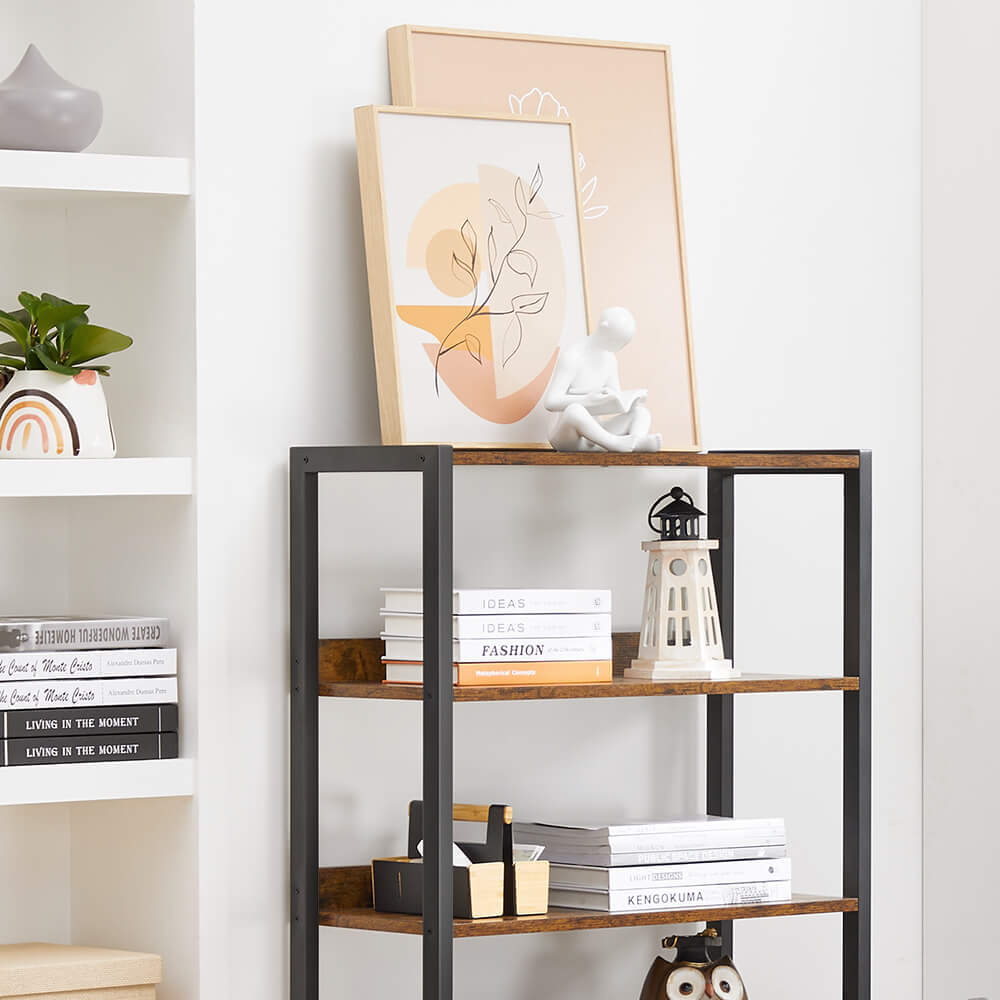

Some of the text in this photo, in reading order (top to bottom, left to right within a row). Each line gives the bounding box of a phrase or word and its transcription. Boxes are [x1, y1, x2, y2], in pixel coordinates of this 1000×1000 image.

[482, 599, 526, 609] IDEAS
[35, 625, 161, 645] CREATE WONDERFUL HOMELIFE
[482, 623, 525, 633] IDEAS
[481, 644, 545, 657] FASHION
[8, 659, 29, 676] Count
[42, 658, 67, 673] Monte
[69, 657, 93, 674] Cristo
[10, 688, 31, 705] Count
[44, 688, 69, 702] Monte
[71, 687, 95, 704] Cristo
[25, 717, 140, 730] LIVING IN THE MOMENT
[26, 744, 140, 758] LIVING IN THE MOMENT
[627, 891, 704, 906] KENGOKUMA
